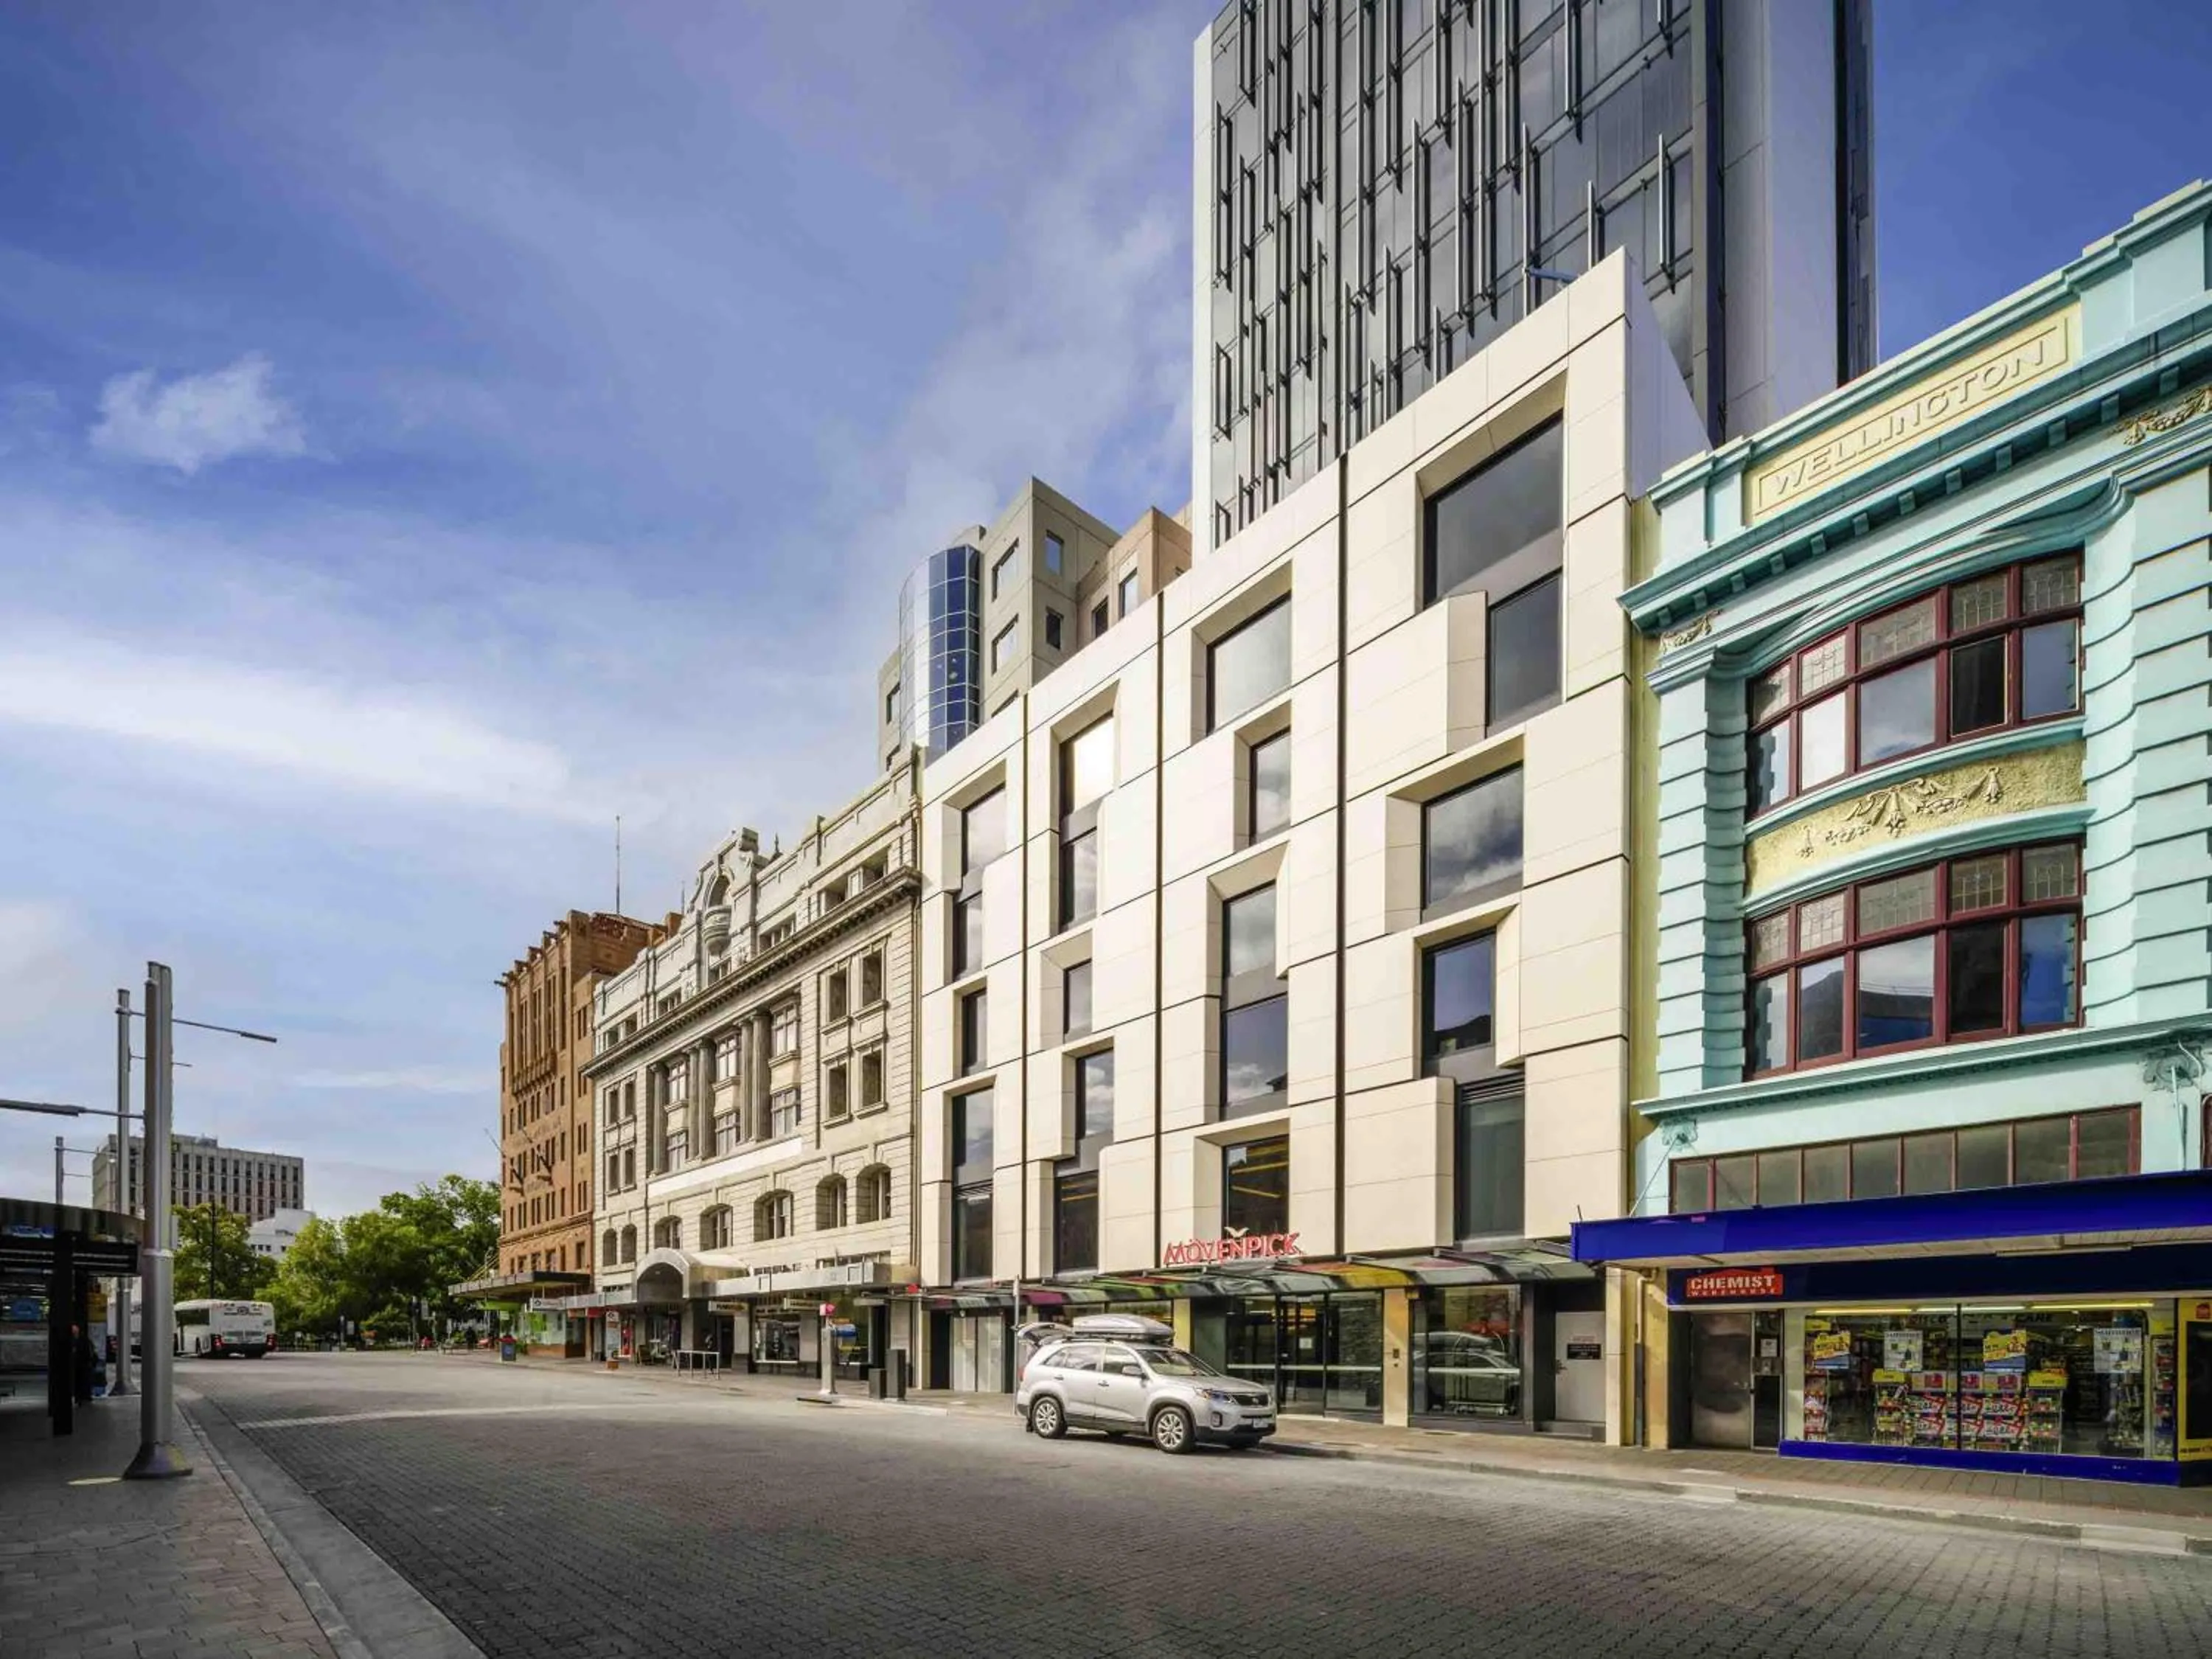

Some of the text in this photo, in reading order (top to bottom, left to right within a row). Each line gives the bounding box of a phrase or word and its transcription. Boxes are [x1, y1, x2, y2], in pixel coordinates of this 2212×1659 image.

[1775, 340, 2045, 495] WELLINGTON
[1164, 1232, 1302, 1265] MÖVENPICK
[1691, 1275, 1775, 1290] CHEMIST
